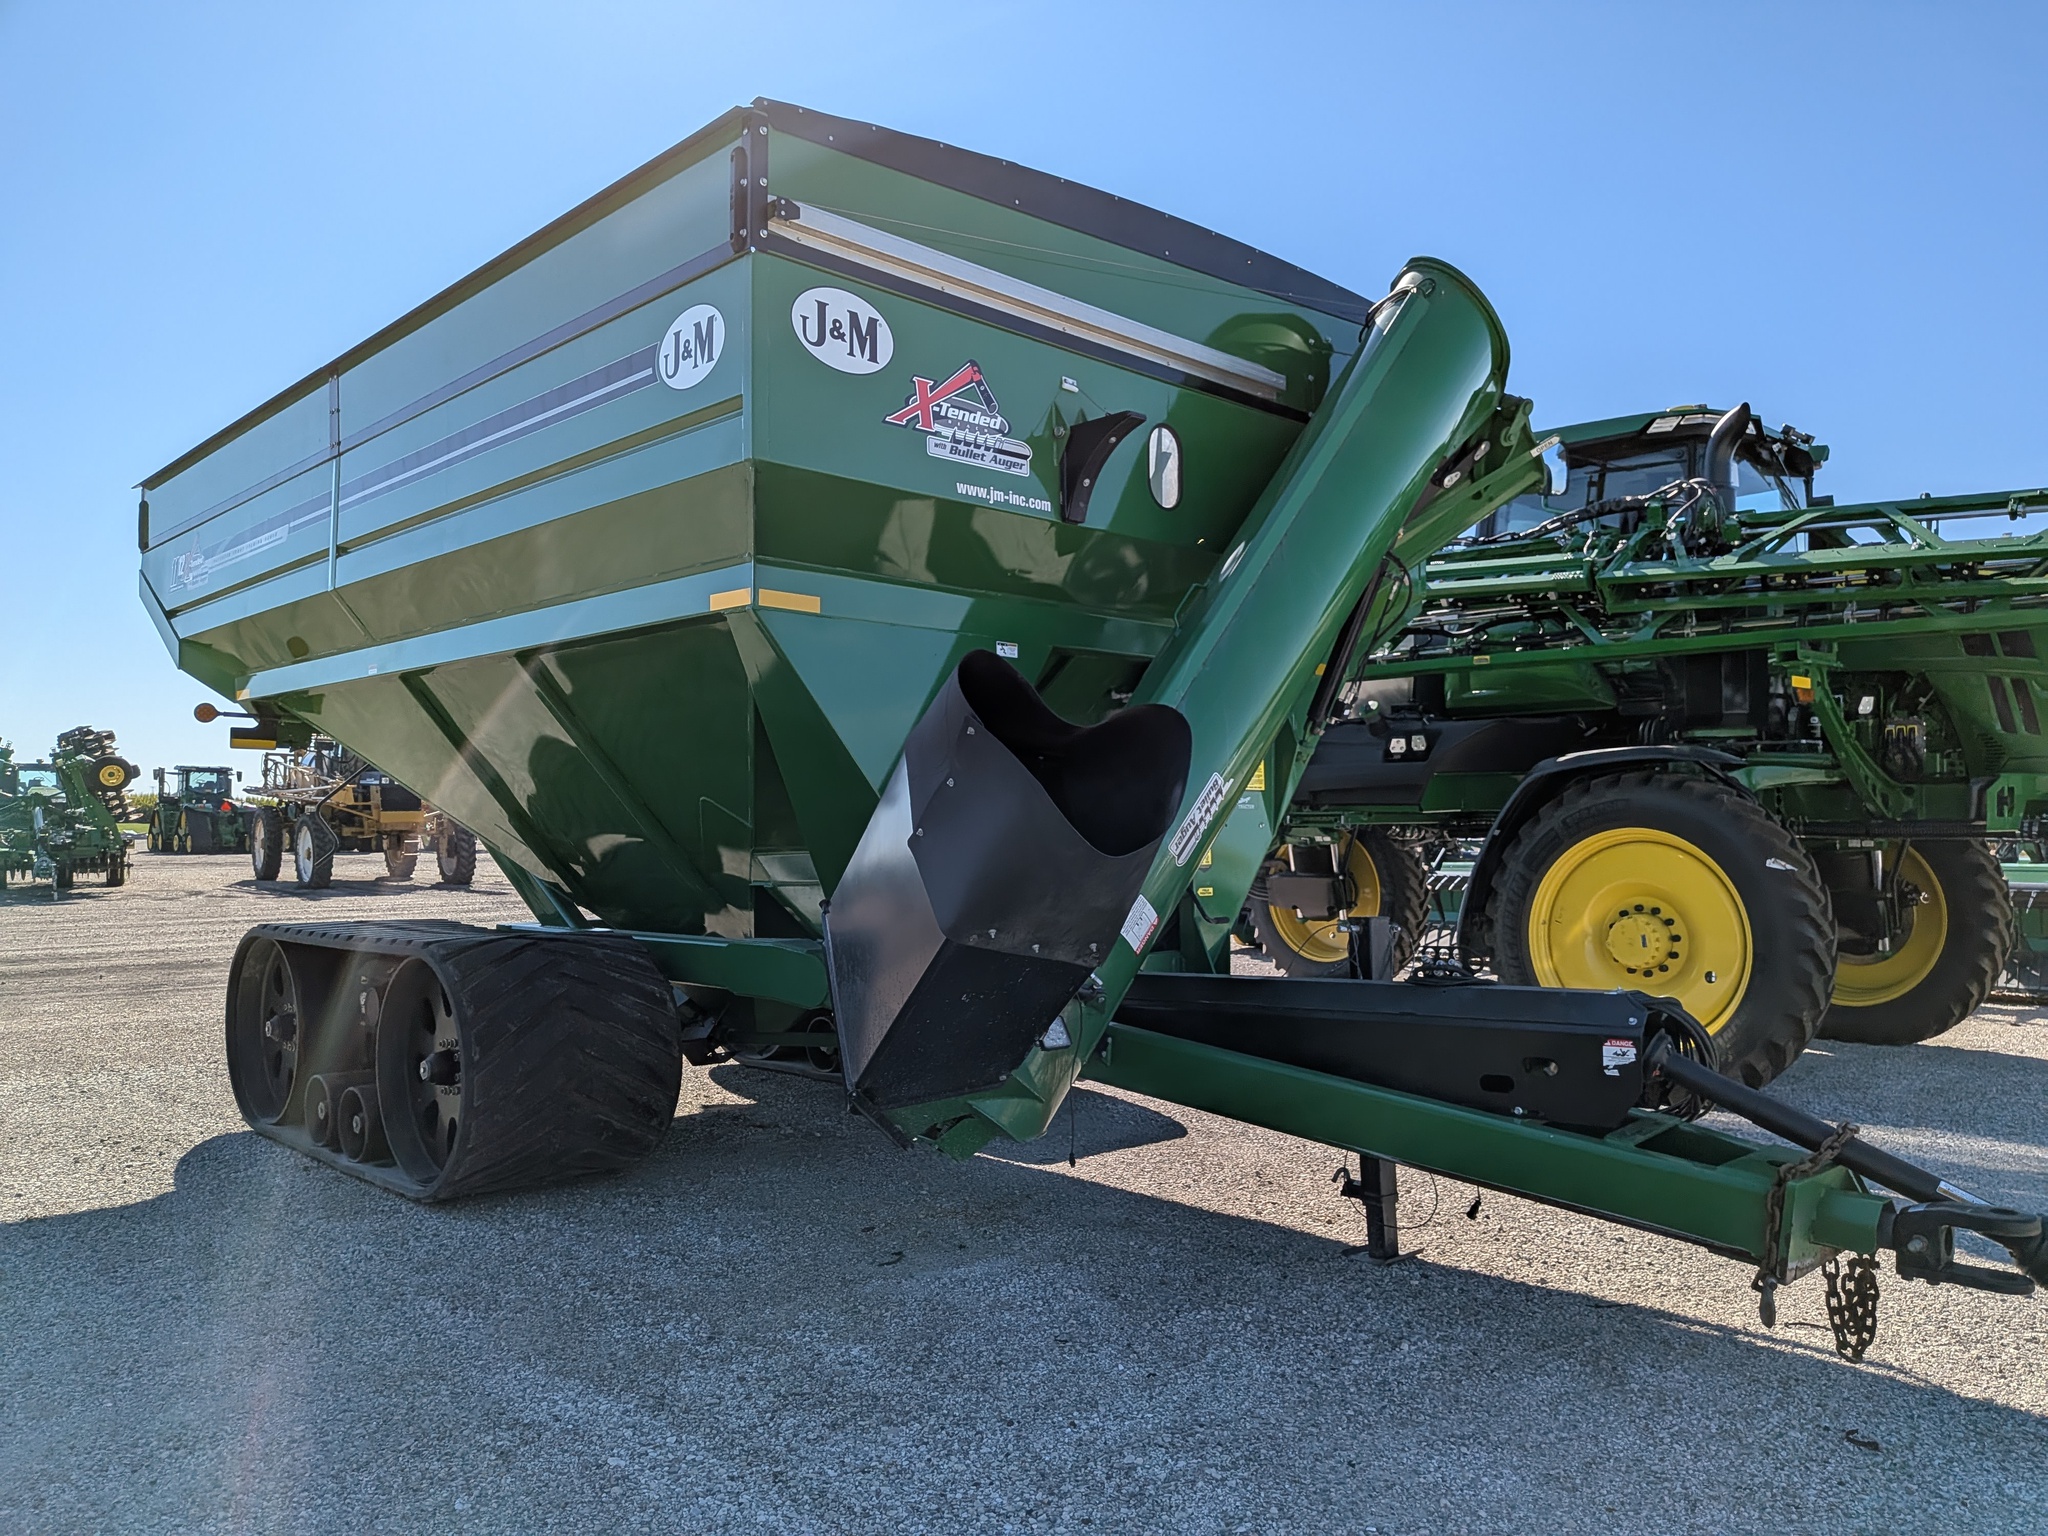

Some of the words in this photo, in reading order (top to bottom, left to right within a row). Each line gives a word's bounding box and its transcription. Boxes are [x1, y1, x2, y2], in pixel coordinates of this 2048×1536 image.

[663, 313, 716, 380] J&M
[800, 299, 880, 364] J&M
[884, 364, 1001, 432] X-Tended
[933, 441, 947, 450] with
[949, 444, 986, 462] Bullet
[989, 455, 1026, 470] Auger
[1535, 440, 1554, 454] OPEN
[956, 482, 1051, 512] www.jm-inc.com
[1196, 778, 1220, 814] Bullet
[1173, 813, 1197, 851] Auger
[1136, 925, 1155, 955] DANGER
